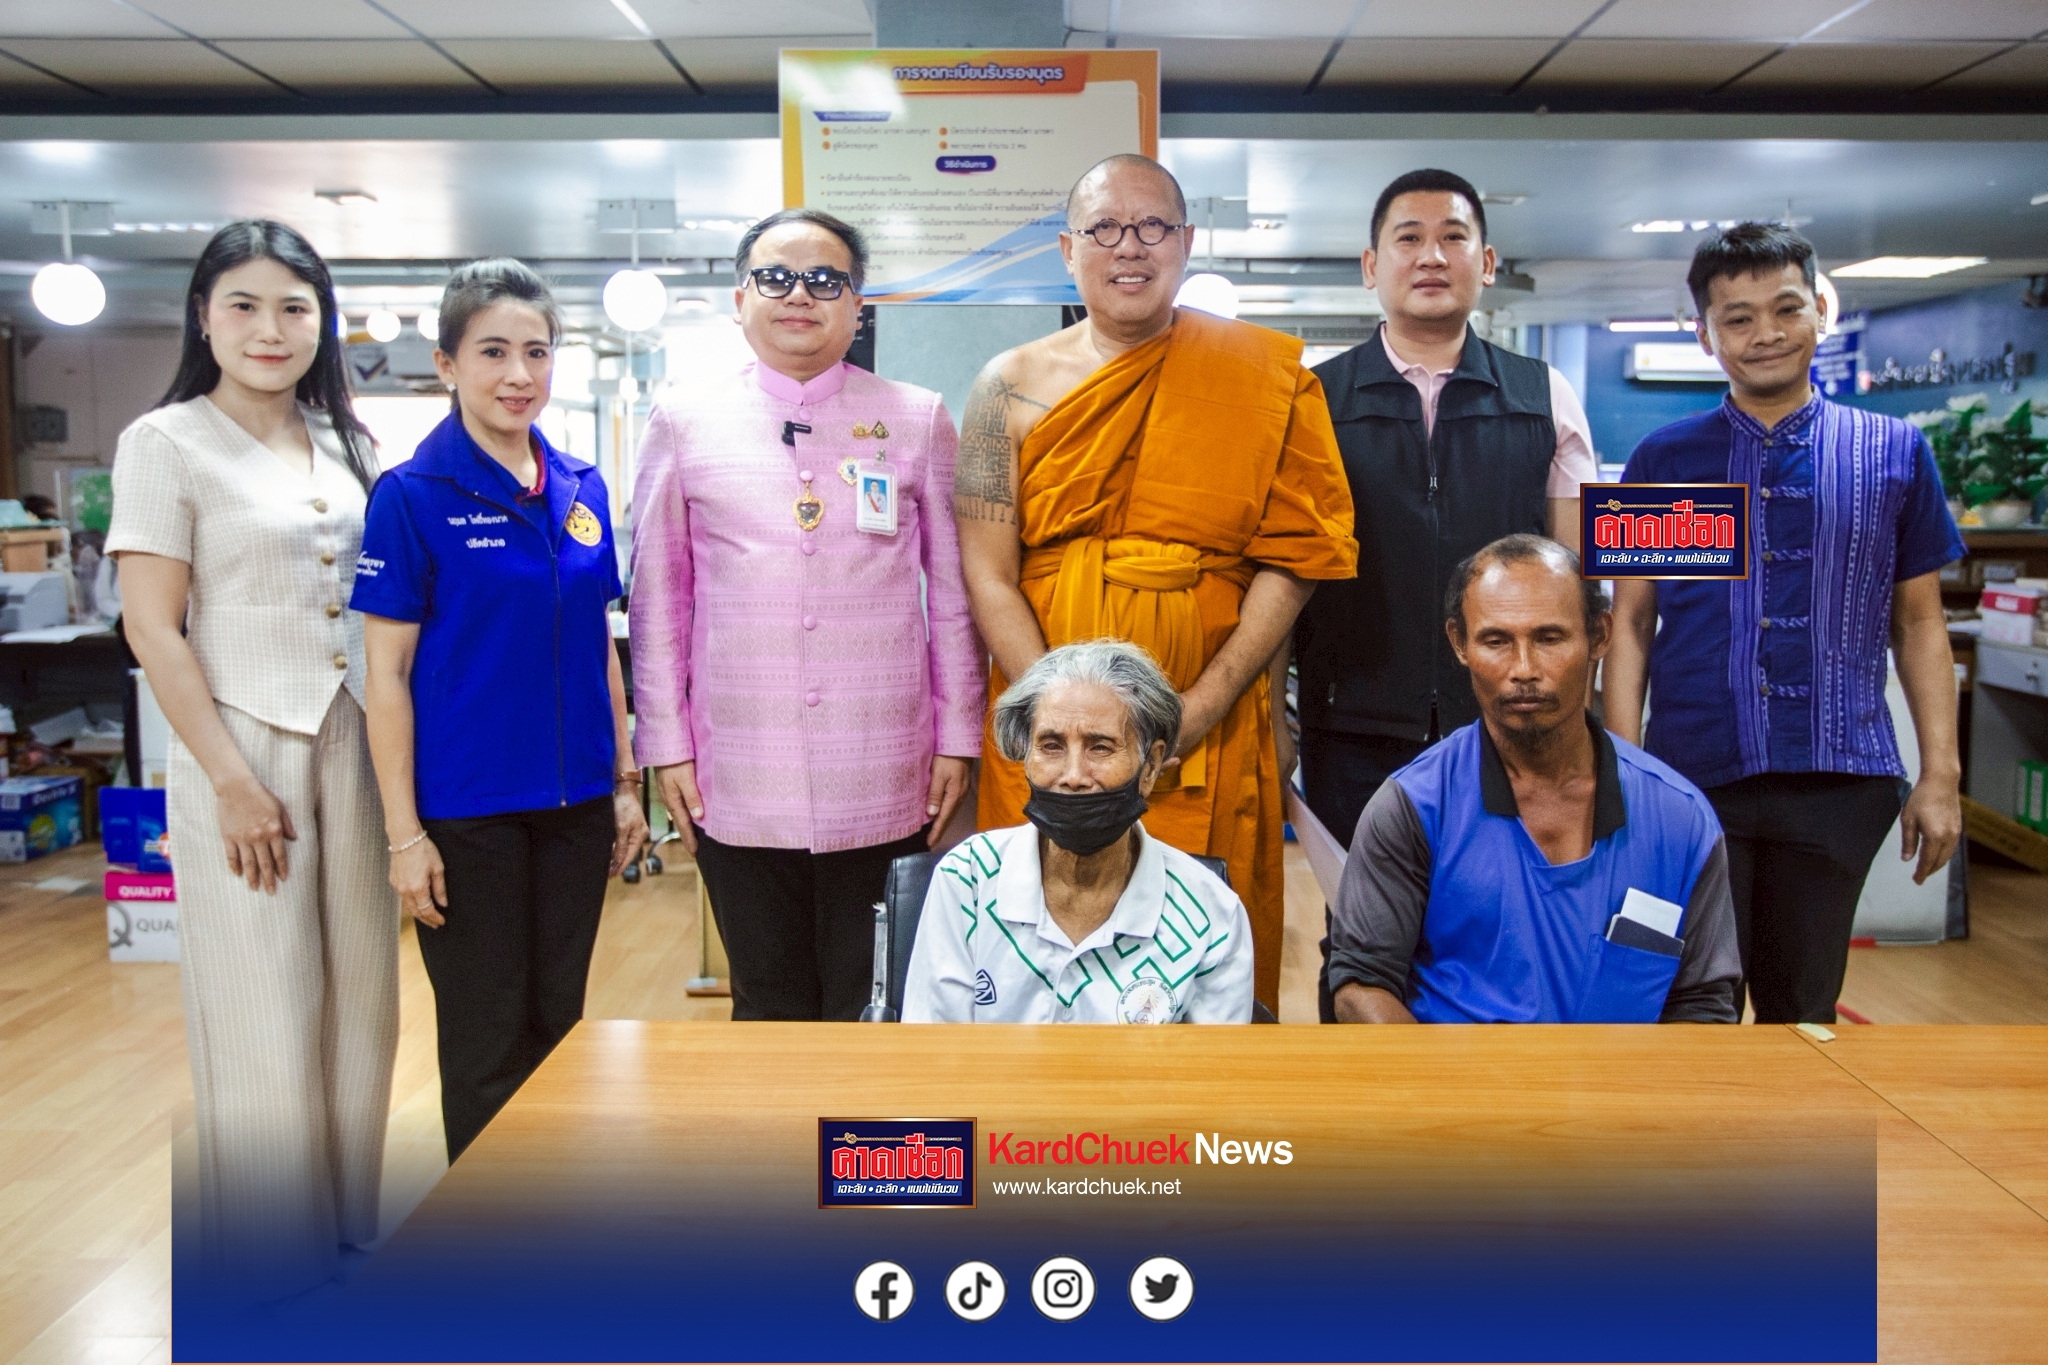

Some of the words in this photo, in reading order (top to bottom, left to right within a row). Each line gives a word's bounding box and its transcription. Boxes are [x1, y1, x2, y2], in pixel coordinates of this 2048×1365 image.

[893, 62, 1064, 84] การจดทะเบียนรับรองบุตร
[118, 885, 172, 899] QUALITY
